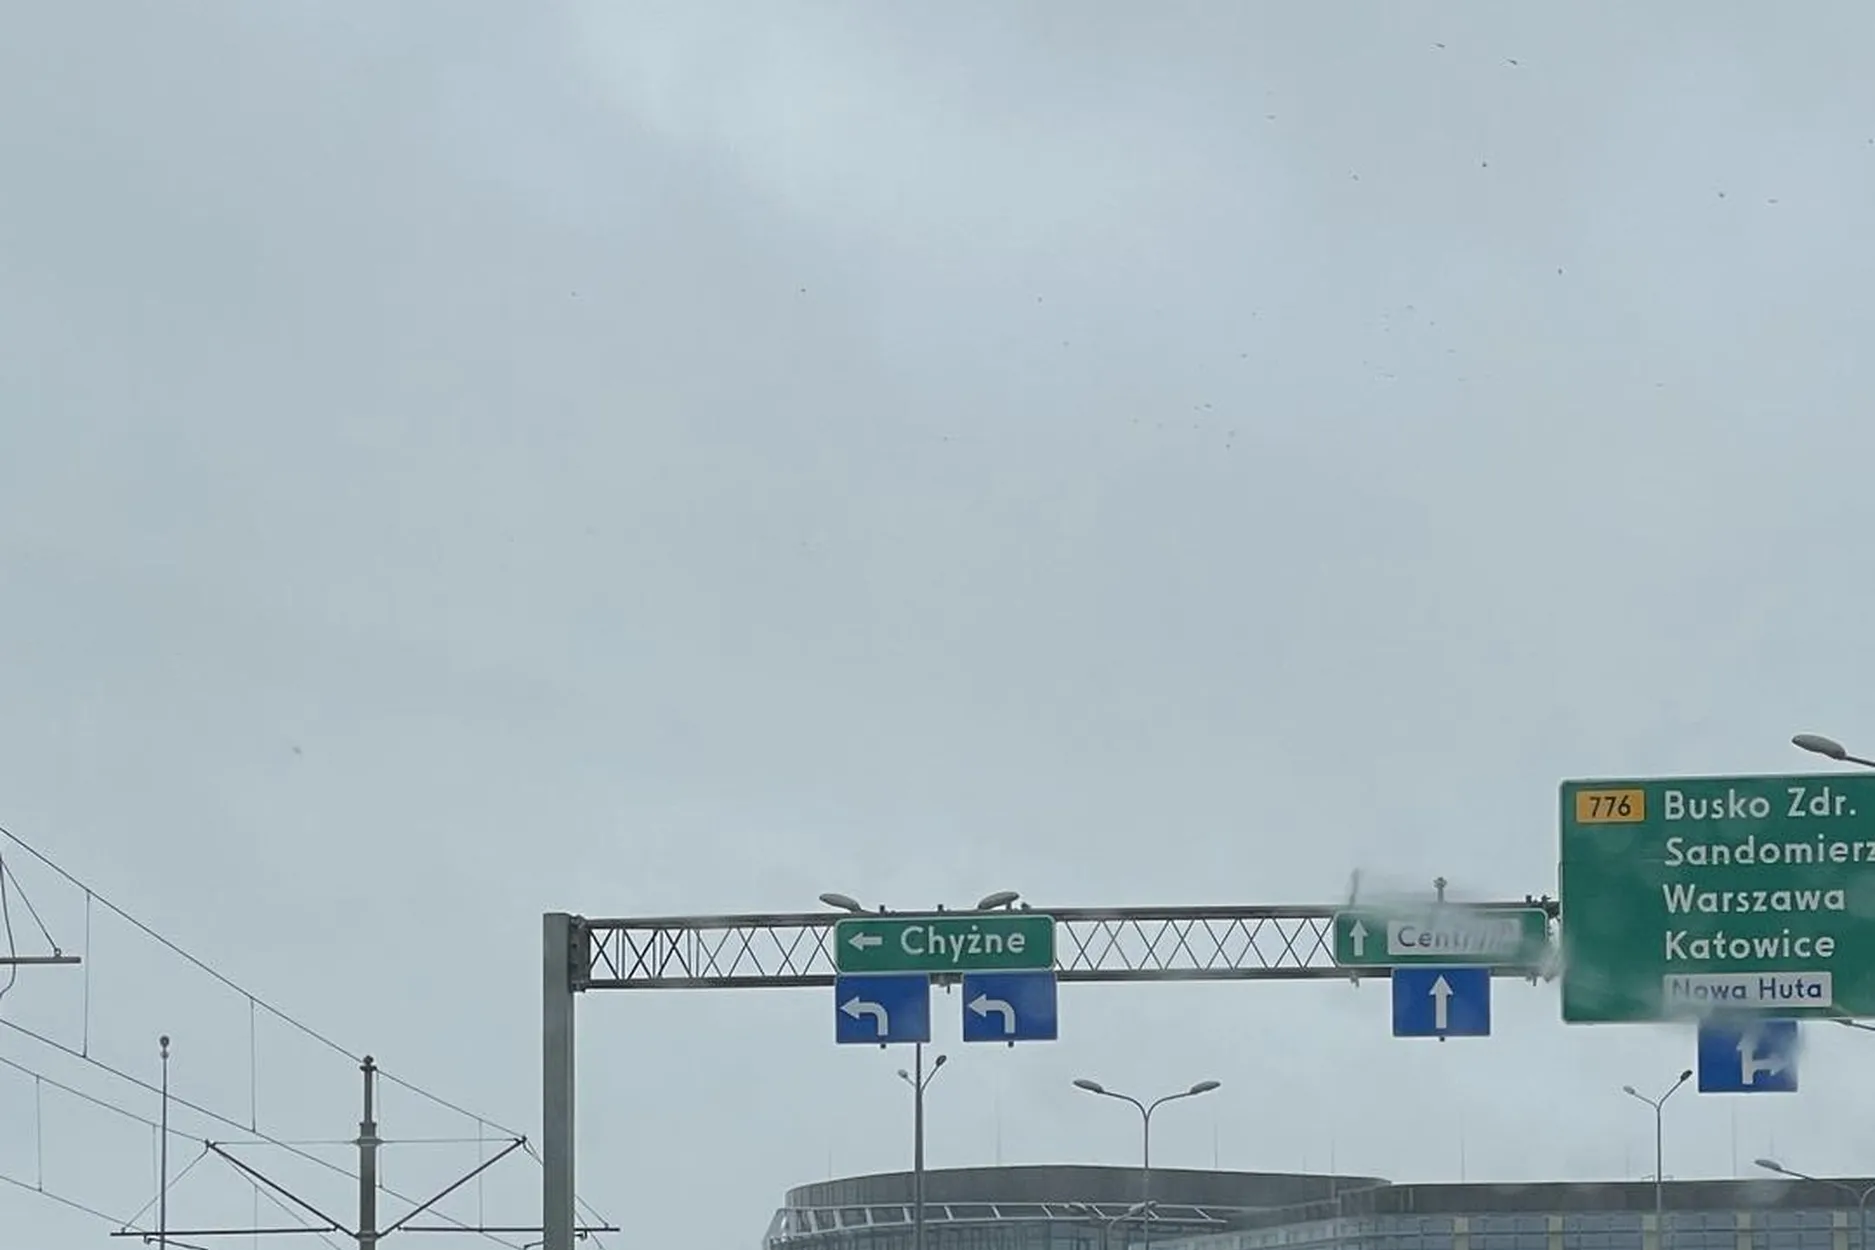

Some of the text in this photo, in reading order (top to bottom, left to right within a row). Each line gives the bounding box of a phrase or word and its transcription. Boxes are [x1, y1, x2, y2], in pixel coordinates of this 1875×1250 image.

[1589, 795, 1632, 817] 776
[1664, 787, 1857, 820] Busko Zdr.
[1663, 884, 1846, 913] Warszawa
[900, 925, 1026, 963] Chyżne
[1665, 928, 1836, 960] Katowice
[1671, 977, 1822, 1000] Nowa Huta
